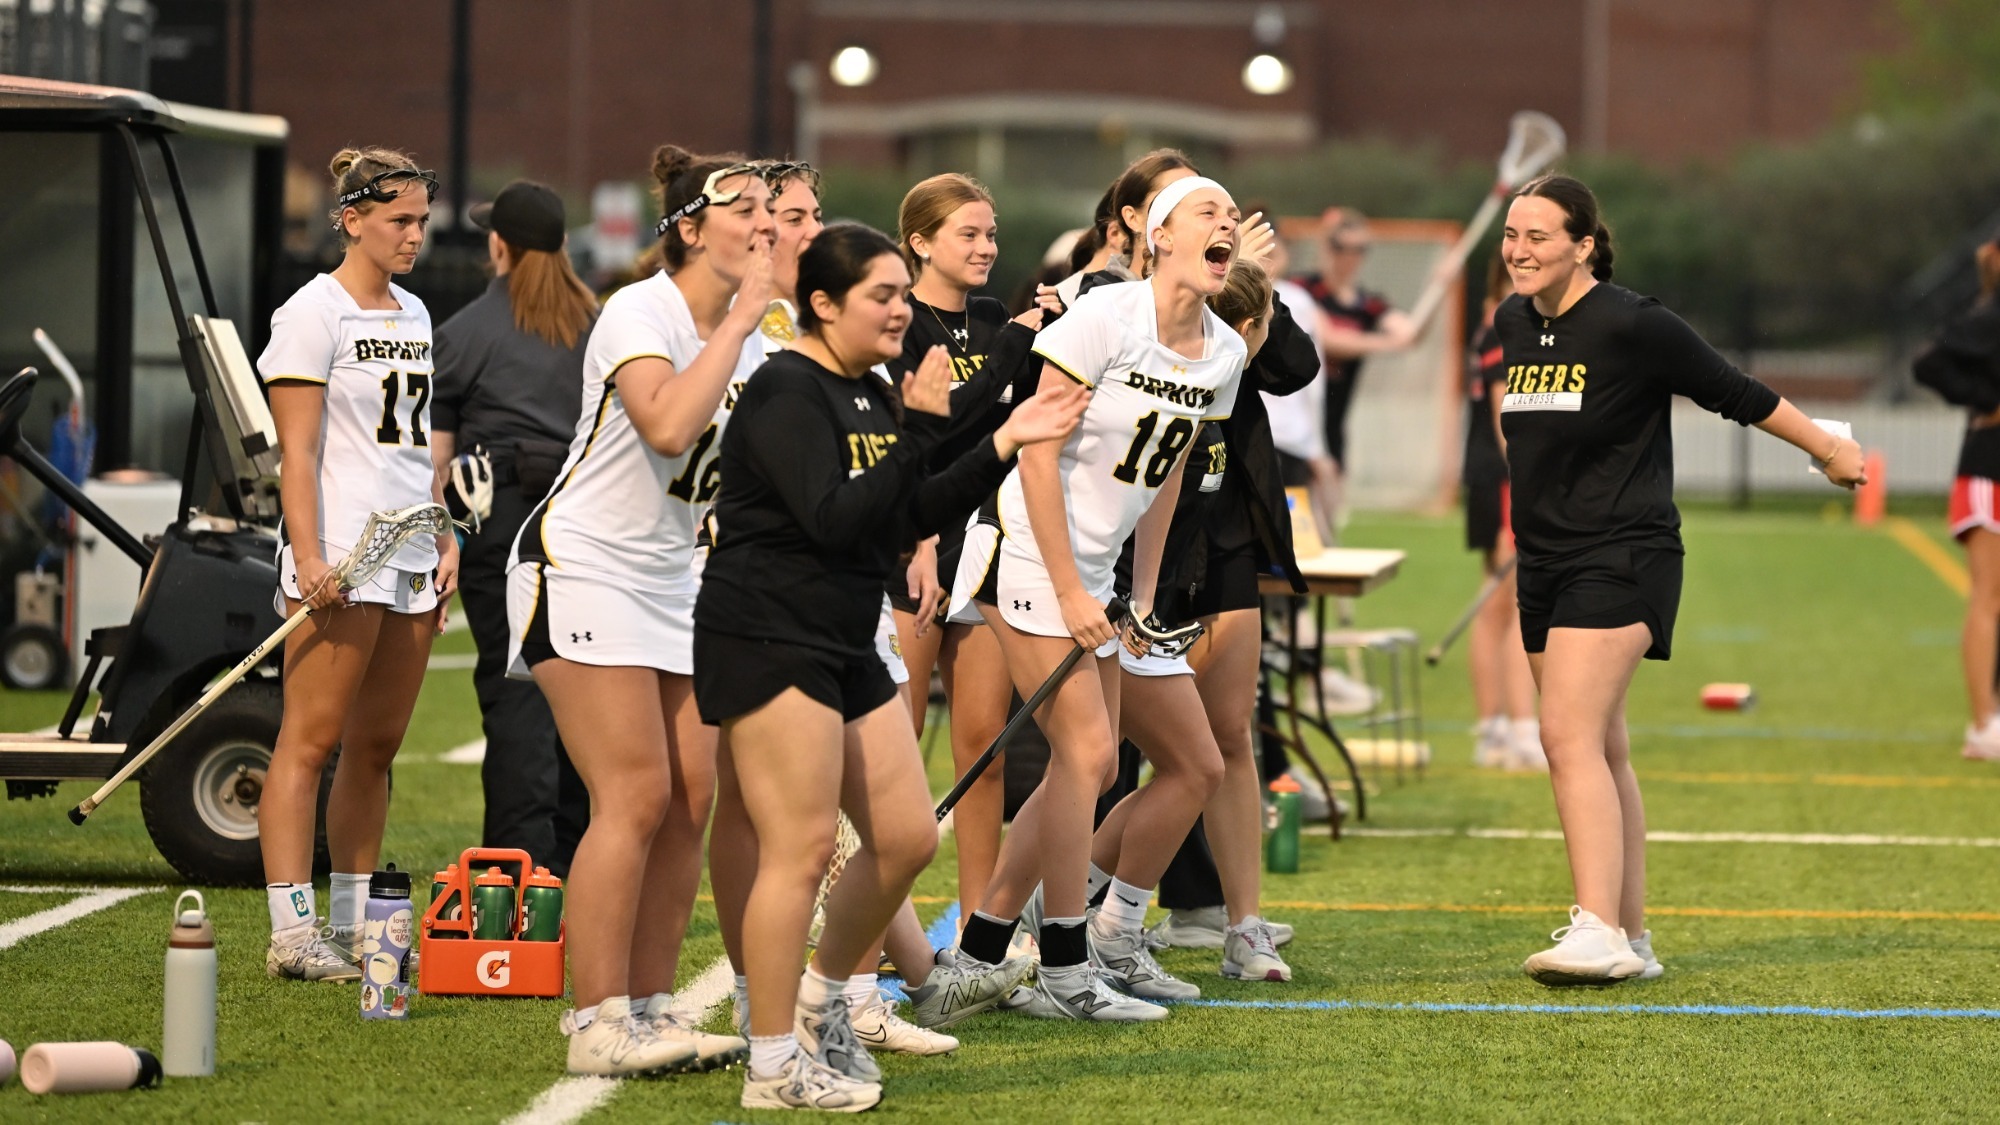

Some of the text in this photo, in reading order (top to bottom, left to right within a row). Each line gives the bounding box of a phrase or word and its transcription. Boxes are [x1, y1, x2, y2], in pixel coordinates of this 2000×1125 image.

[376, 369, 430, 449] 17
[1513, 394, 1556, 405] LACROSSE
[1112, 409, 1195, 488] 18
[476, 950, 511, 989] G
